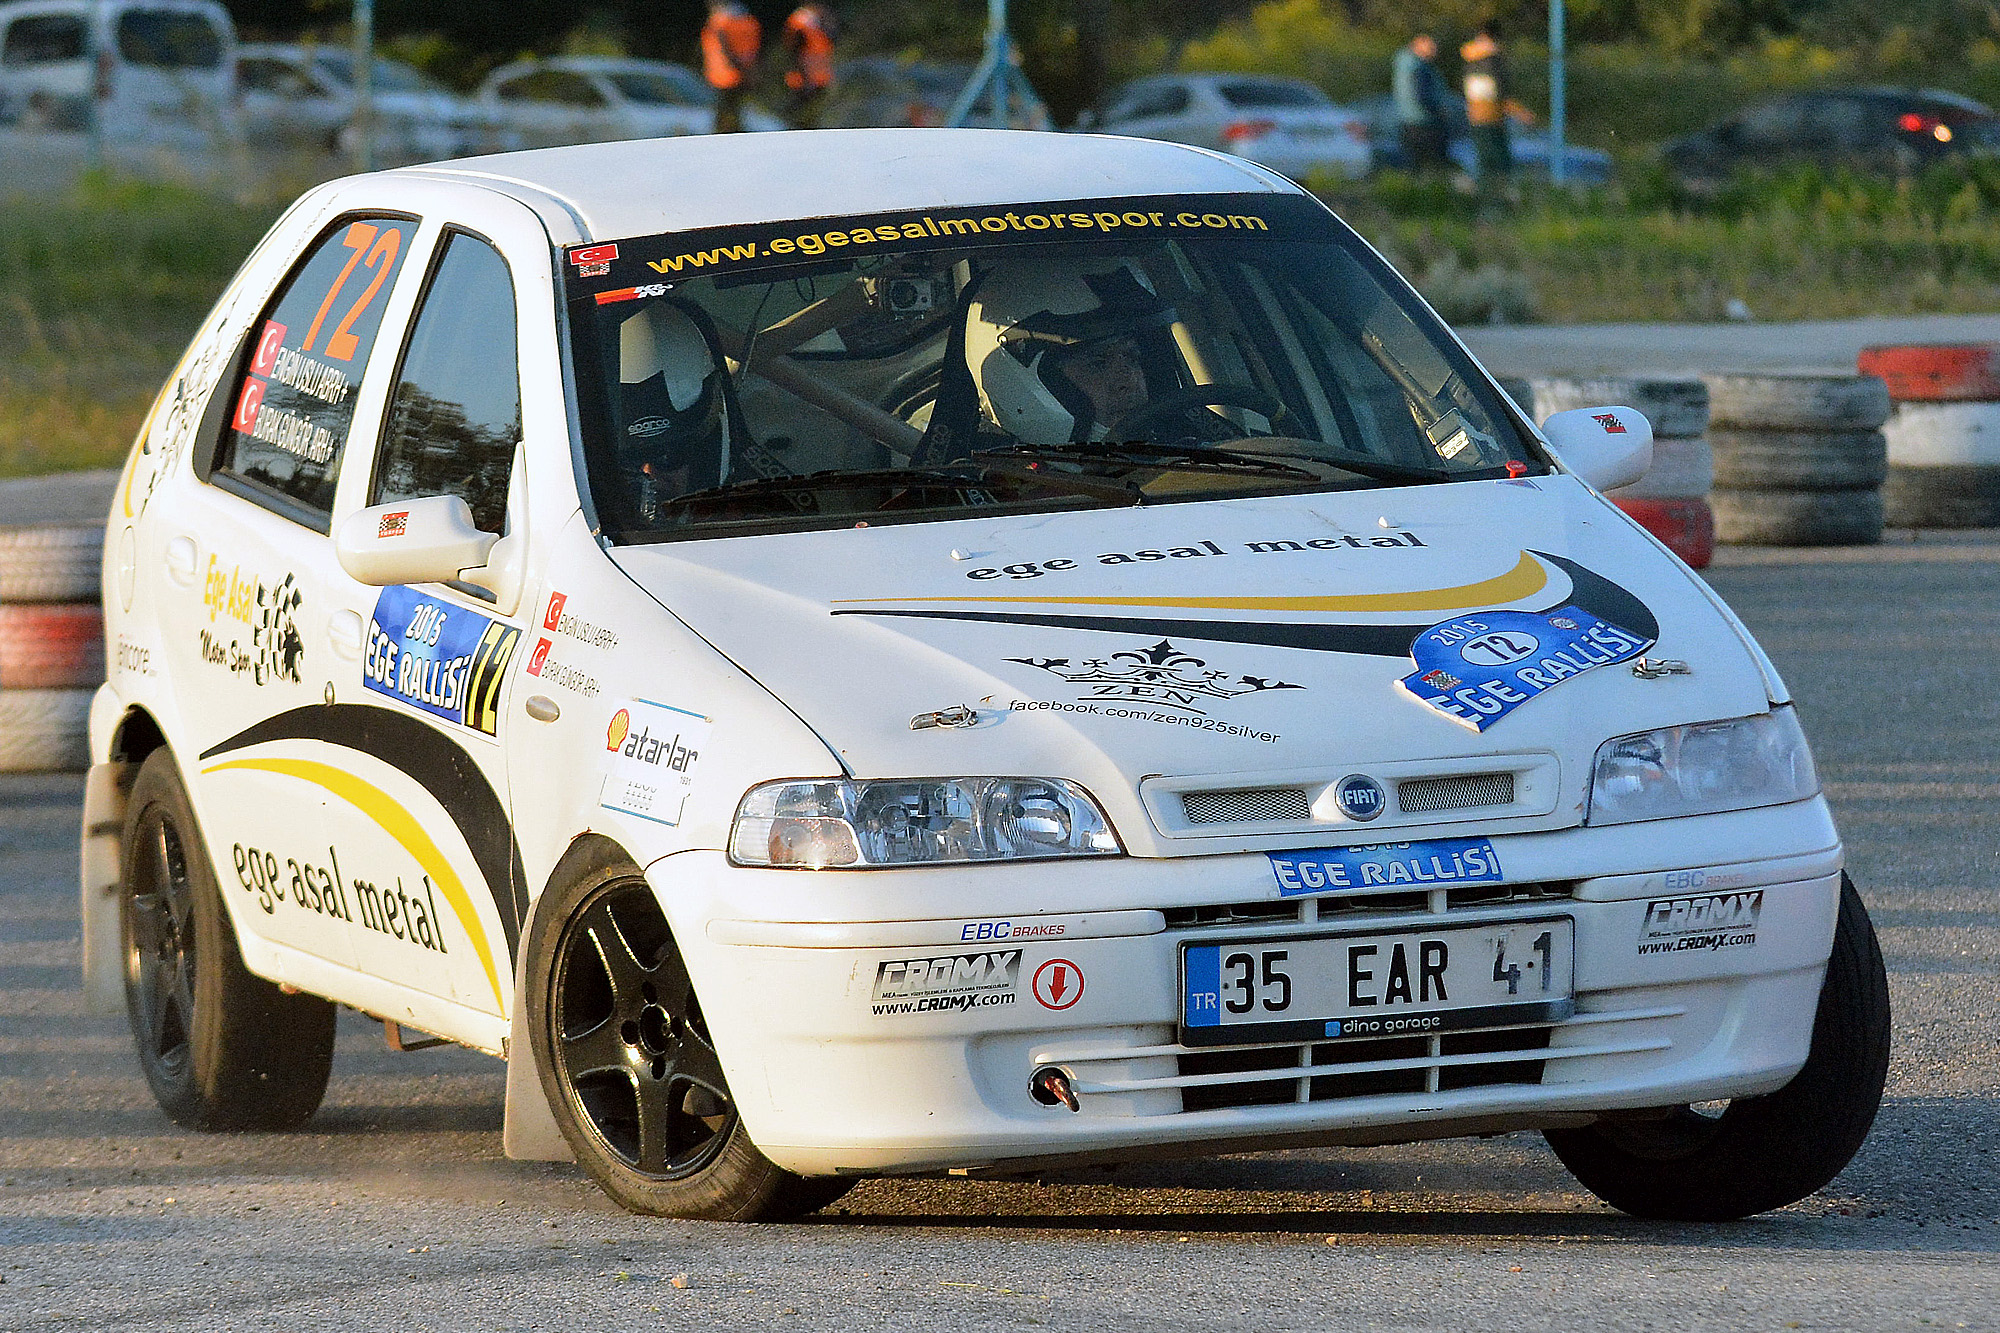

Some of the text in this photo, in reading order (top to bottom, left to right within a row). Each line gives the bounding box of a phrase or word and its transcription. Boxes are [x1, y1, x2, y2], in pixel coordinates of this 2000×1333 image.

[647, 211, 1269, 274] www.egeasalmotorspor.com
[302, 222, 401, 362] 72
[628, 418, 670, 433] sparco
[965, 531, 1428, 582] ege asal metal
[204, 553, 259, 625] Ege Asal
[405, 603, 448, 648] 2015
[1429, 620, 1490, 647] 2015
[364, 619, 399, 690] EGE
[1468, 634, 1532, 662] 72
[466, 622, 518, 735] 72
[1091, 683, 1200, 707] ZEN
[1424, 680, 1529, 724] EGE
[1008, 699, 1282, 746] facebook.com/zen925silver
[625, 725, 699, 773] atarlar
[1343, 787, 1377, 807] FIAT
[1273, 859, 1351, 889] EGE
[1665, 870, 1705, 889] EBC
[233, 841, 448, 955] ege asal metal
[1650, 892, 1760, 926] CROMX
[960, 921, 1065, 941] EBC BRAKES
[1638, 933, 1756, 955] www.CROMX.com
[880, 951, 1017, 988] CROMX
[1224, 931, 1552, 1014] 35 EAR 41
[872, 992, 1016, 1015] www.CROMX.com
[1192, 991, 1218, 1011] TR
[1343, 1015, 1441, 1034] dino garage
